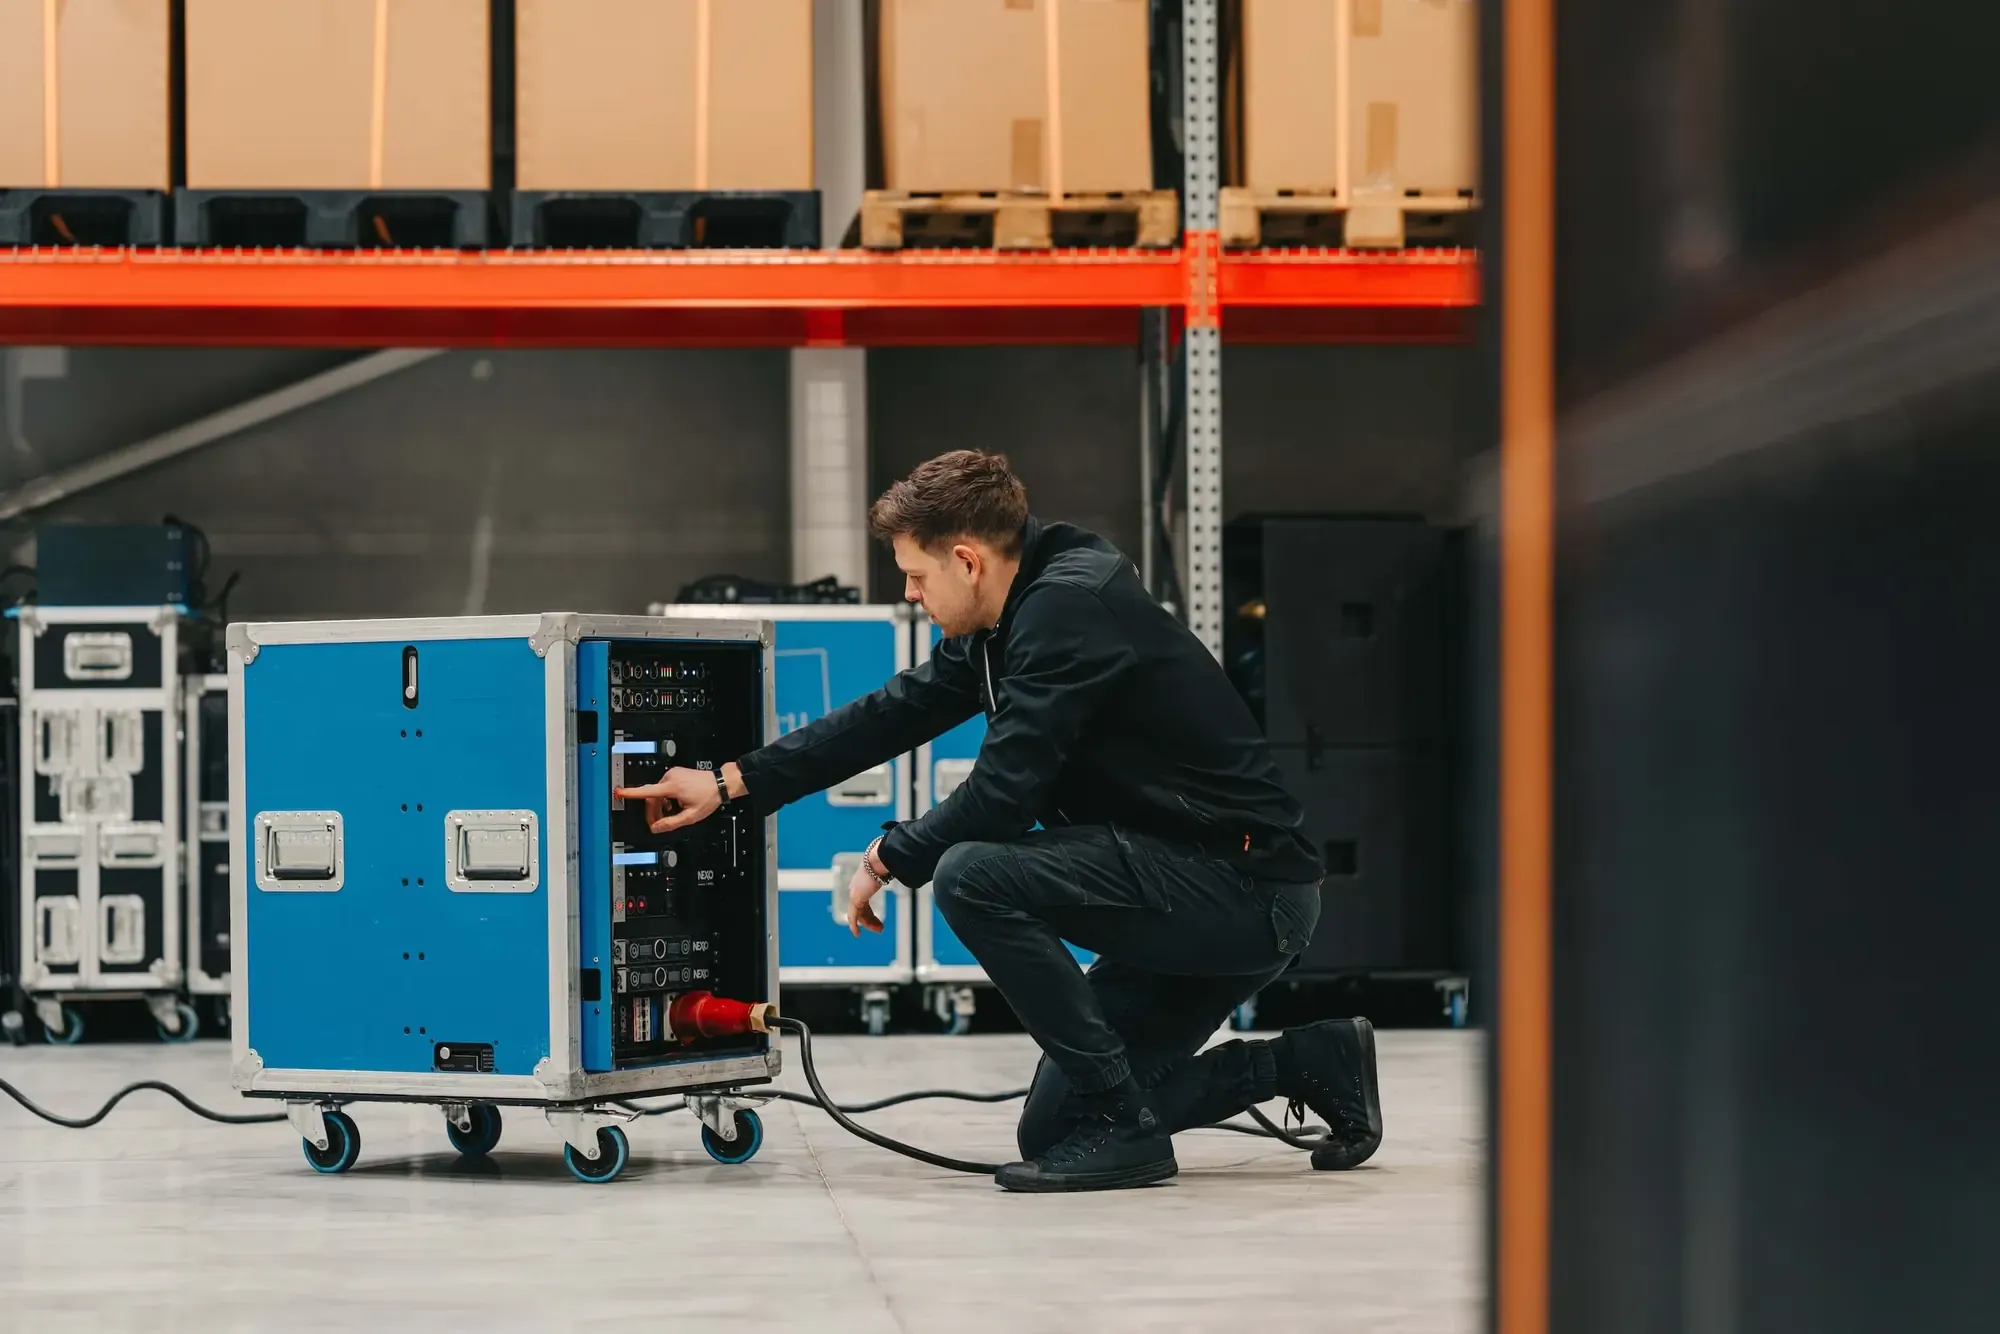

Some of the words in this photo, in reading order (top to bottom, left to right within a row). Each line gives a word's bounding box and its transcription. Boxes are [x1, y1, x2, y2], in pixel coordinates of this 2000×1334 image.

[696, 760, 713, 770] NEXO
[697, 870, 714, 880] NEXO
[692, 941, 709, 951] NEXO
[693, 969, 709, 979] NEXO
